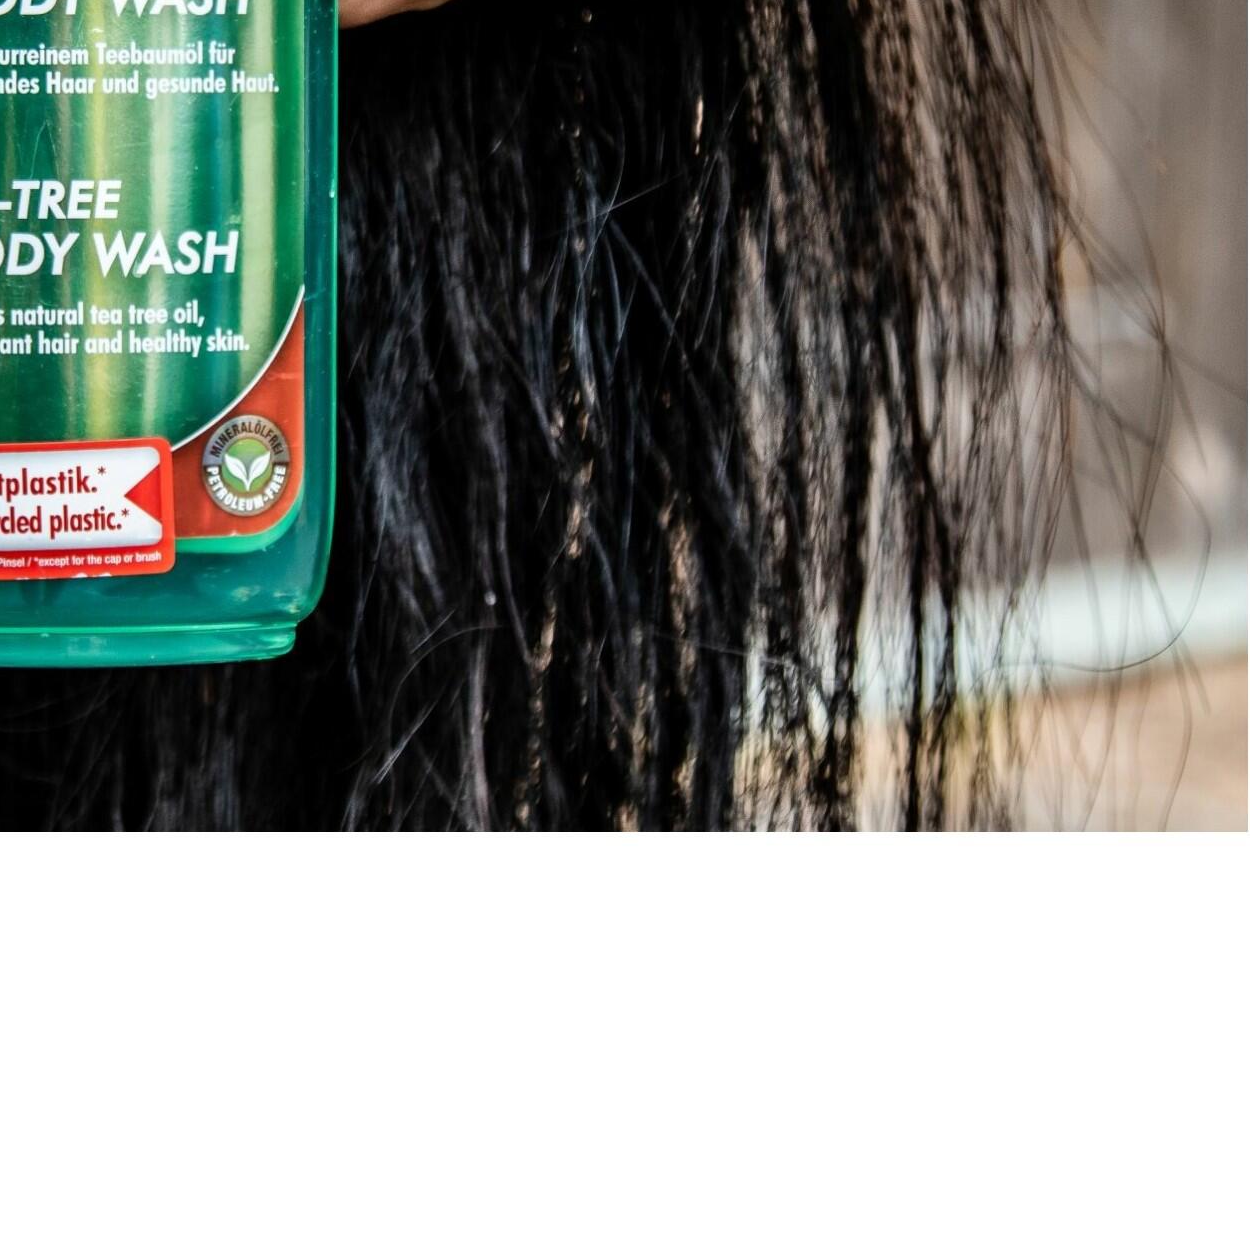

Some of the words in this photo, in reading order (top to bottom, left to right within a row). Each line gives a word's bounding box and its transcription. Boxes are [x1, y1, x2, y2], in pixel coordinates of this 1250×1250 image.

[95, 41, 203, 65] Teebaumöl
[209, 40, 236, 65] für
[46, 71, 96, 94] Haar
[102, 70, 139, 94] und
[145, 69, 226, 99] gesunde
[231, 70, 280, 93] Haut.
[93, 230, 240, 277] WASH
[11, 301, 84, 325] natural
[90, 304, 123, 325] tea
[129, 304, 168, 325] tree
[173, 299, 205, 327] oil,
[38, 330, 79, 354] hair
[85, 330, 123, 354] and
[129, 328, 202, 358] healthy
[206, 327, 250, 352] skin.
[209, 420, 285, 459] MINERALÖLFREI
[206, 465, 287, 511] PETROLEUM-FREE
[72, 554, 84, 565] for
[87, 553, 102, 565] the
[104, 554, 121, 567] cap
[123, 554, 133, 563] or
[135, 550, 162, 562] brush
